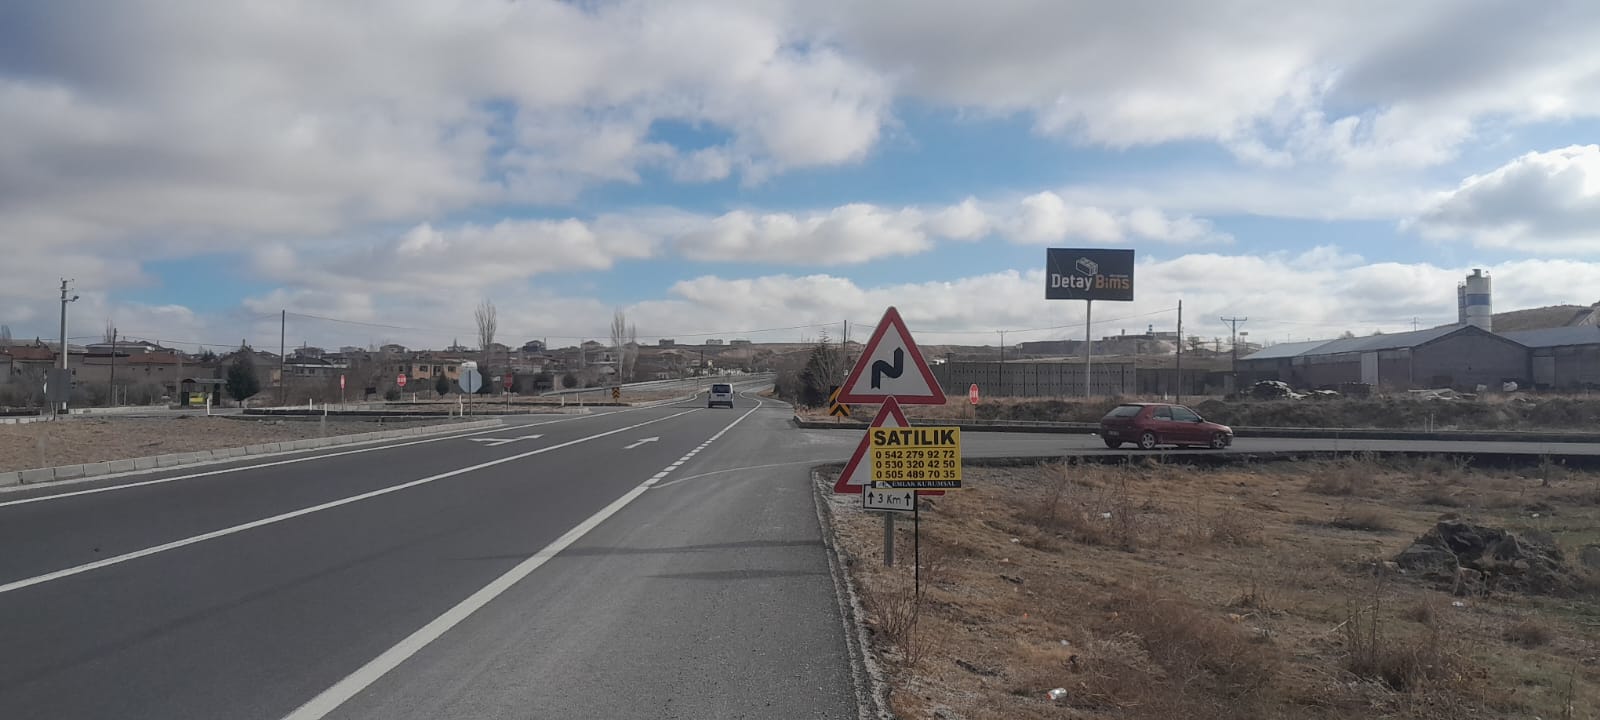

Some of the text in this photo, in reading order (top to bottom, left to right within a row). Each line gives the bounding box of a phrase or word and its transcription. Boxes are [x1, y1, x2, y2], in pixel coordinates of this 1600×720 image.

[1051, 273, 1130, 291] Detay Bims
[874, 430, 955, 446] SATILIK
[875, 450, 955, 459] 0 542 279 92 72
[876, 460, 955, 469] 0 530 320 42 50
[876, 470, 956, 479] 0 505 489 70 35
[877, 494, 901, 504] 3 Km
